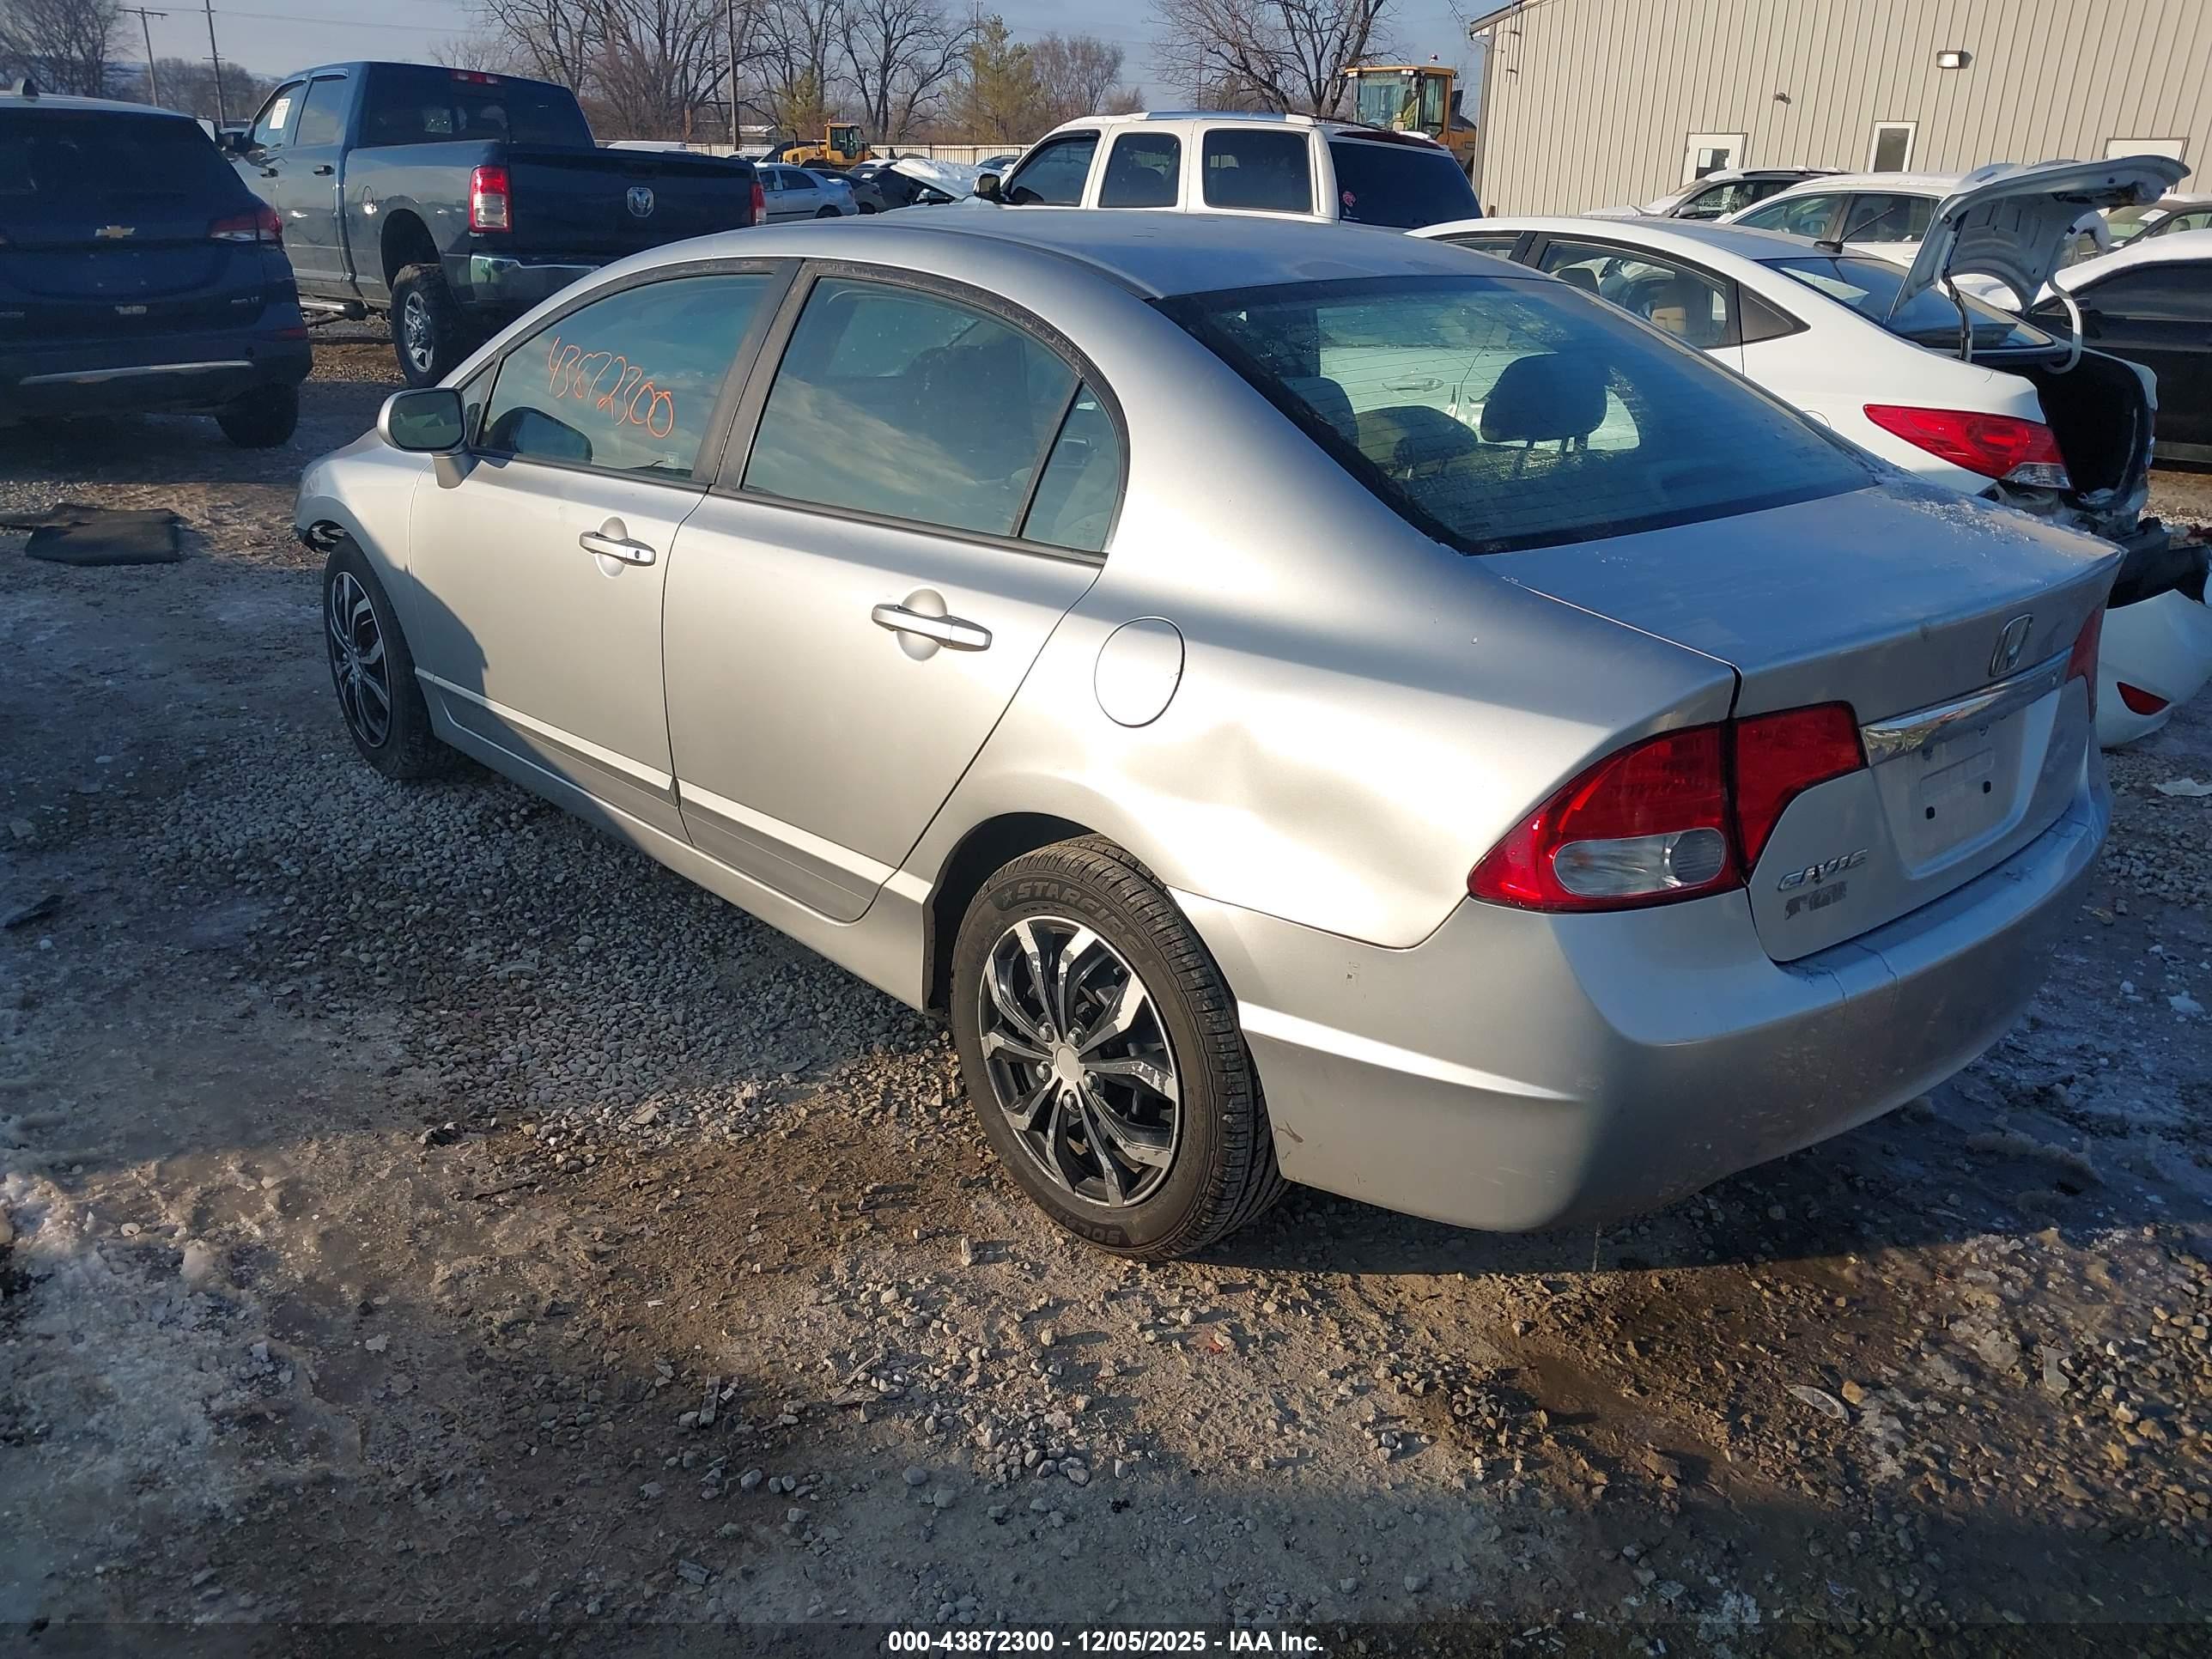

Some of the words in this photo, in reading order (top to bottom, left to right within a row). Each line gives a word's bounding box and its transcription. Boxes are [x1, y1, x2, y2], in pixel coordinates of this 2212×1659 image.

[549, 336, 674, 439] 43872300
[1777, 845, 1869, 891] CIVIC
[1016, 881, 1148, 951] STARFIRE
